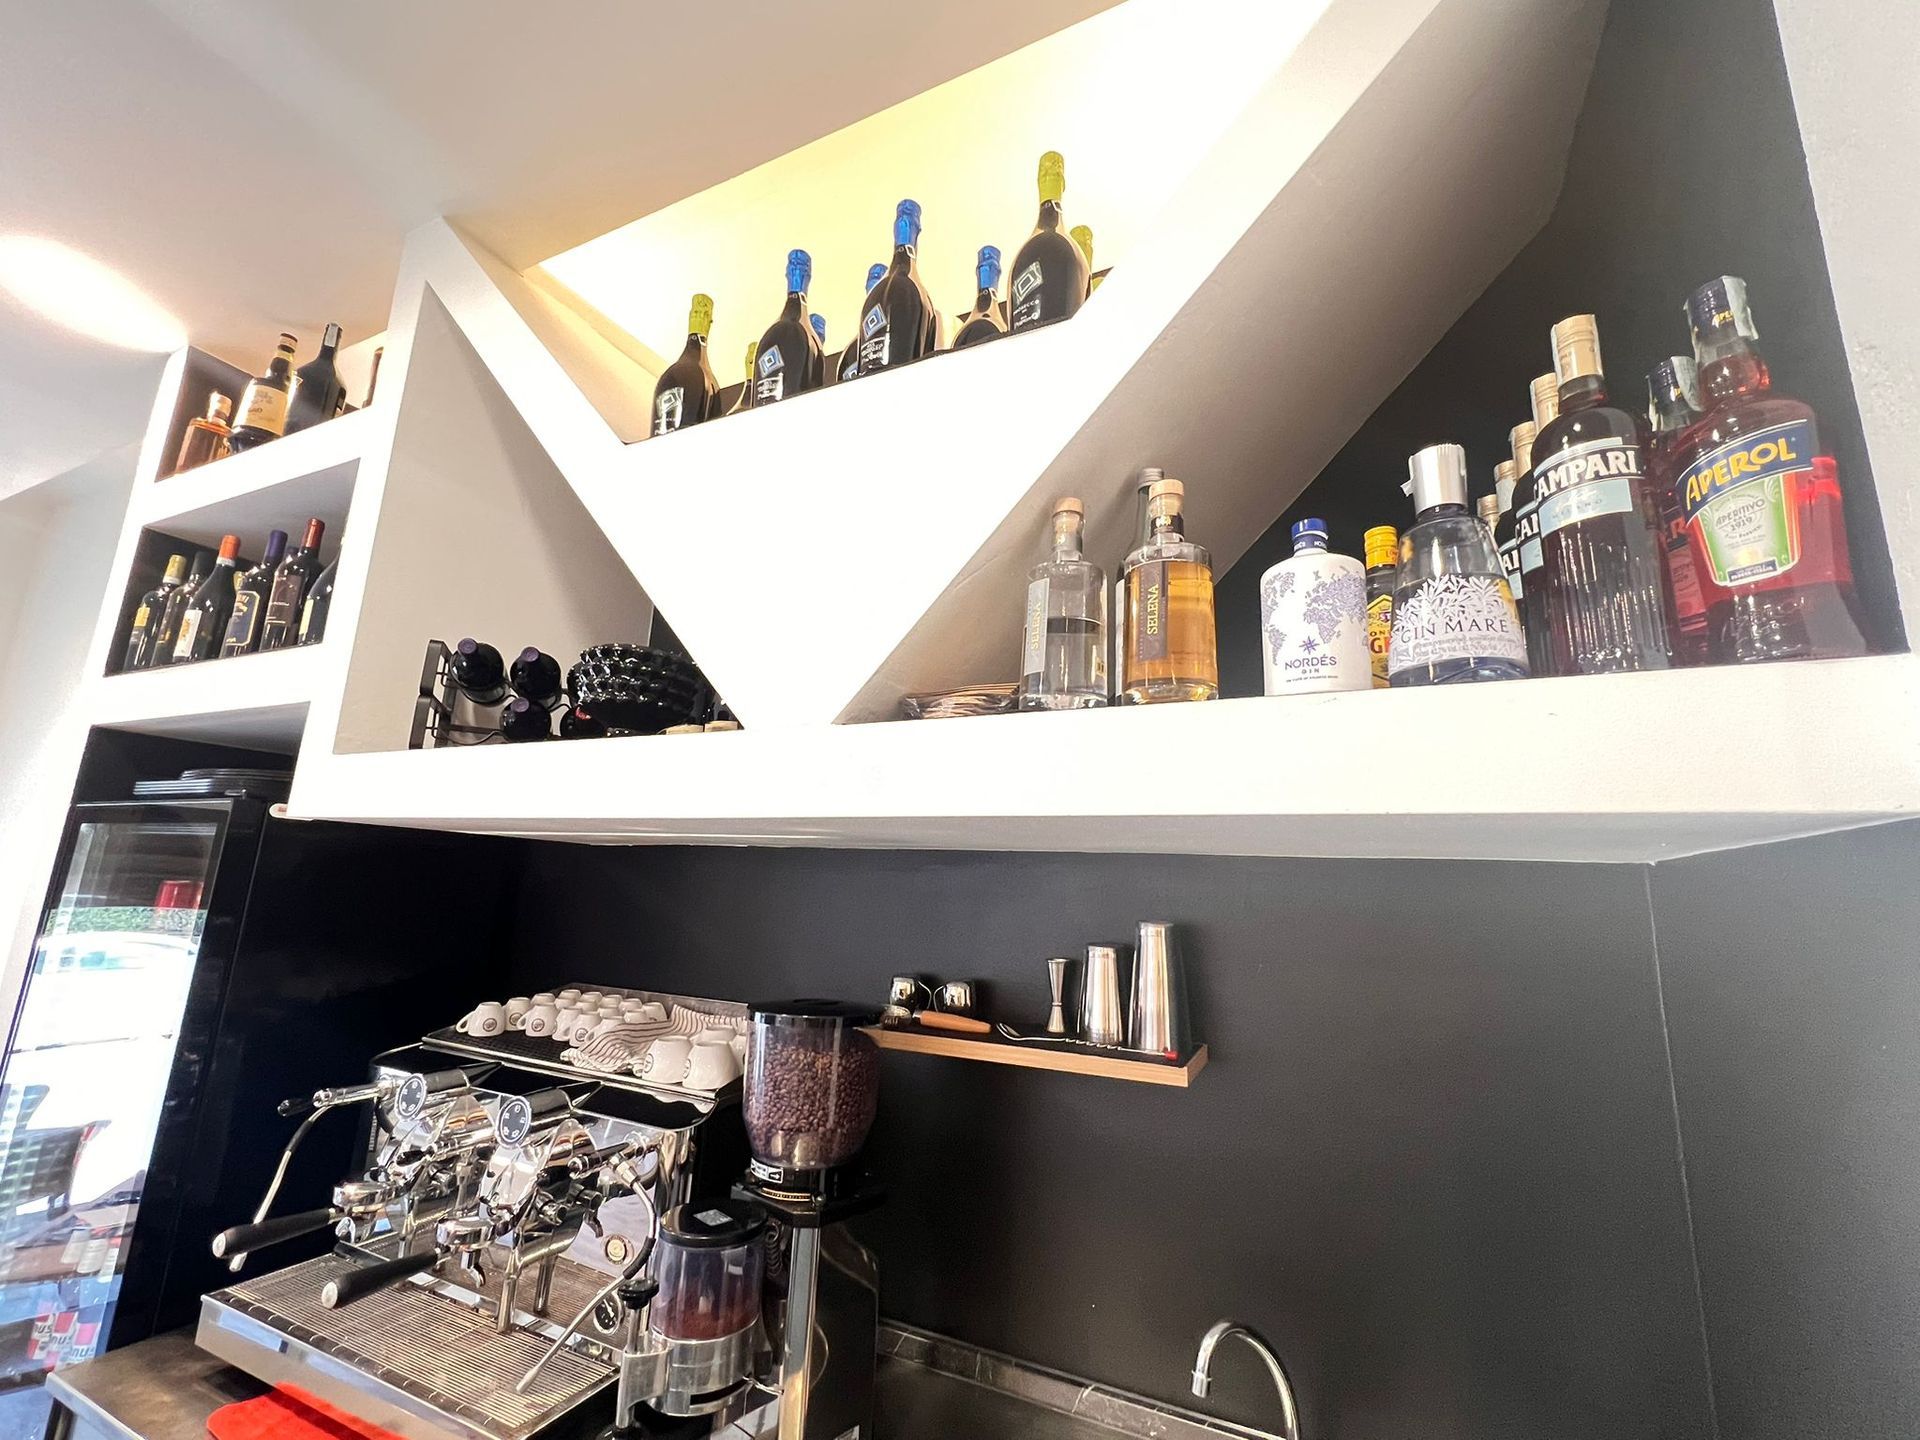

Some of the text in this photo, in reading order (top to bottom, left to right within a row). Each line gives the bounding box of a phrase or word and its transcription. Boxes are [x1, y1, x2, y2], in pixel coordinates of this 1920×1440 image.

[1686, 438, 1797, 511] APEROL
[1715, 498, 1766, 527] APERITIVO
[1031, 602, 1041, 650] SELENA
[1147, 583, 1159, 635] SELENA
[1401, 618, 1510, 644] GIN MARE
[1284, 654, 1337, 671] NORDÉS
